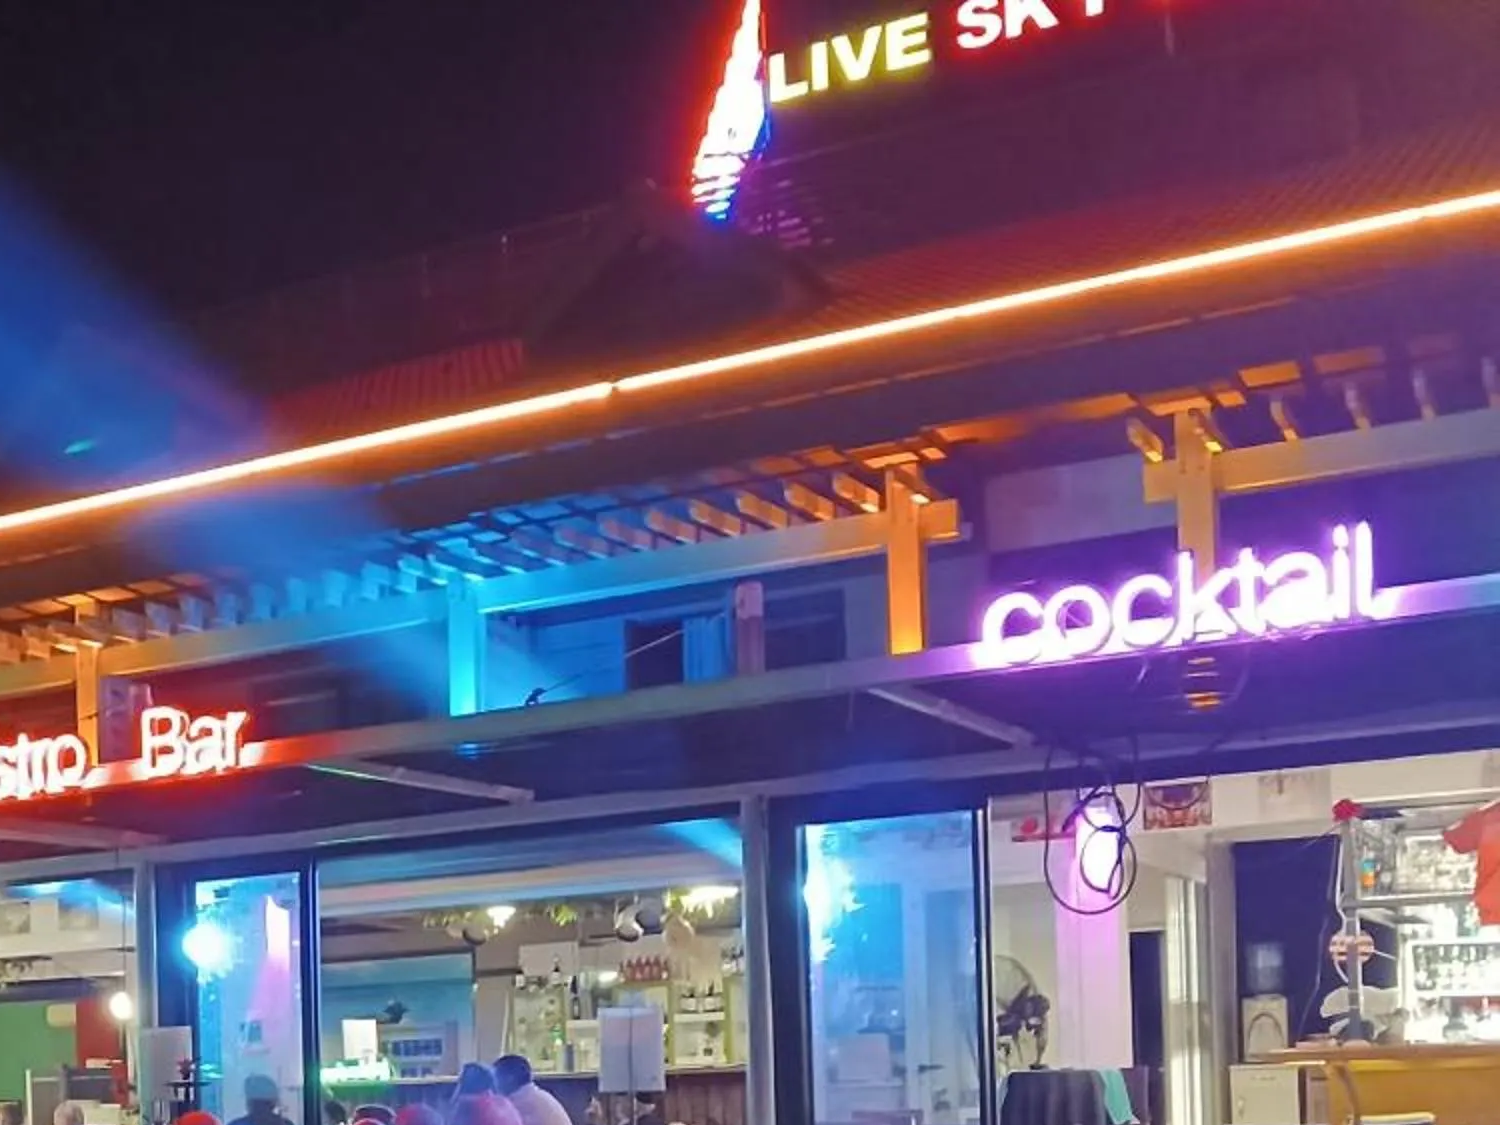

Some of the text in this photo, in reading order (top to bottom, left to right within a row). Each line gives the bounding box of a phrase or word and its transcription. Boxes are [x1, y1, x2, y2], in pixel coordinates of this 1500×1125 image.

[768, 0, 1105, 103] LIVE SK
[977, 519, 1397, 664] cocktail
[138, 705, 248, 779] Bar
